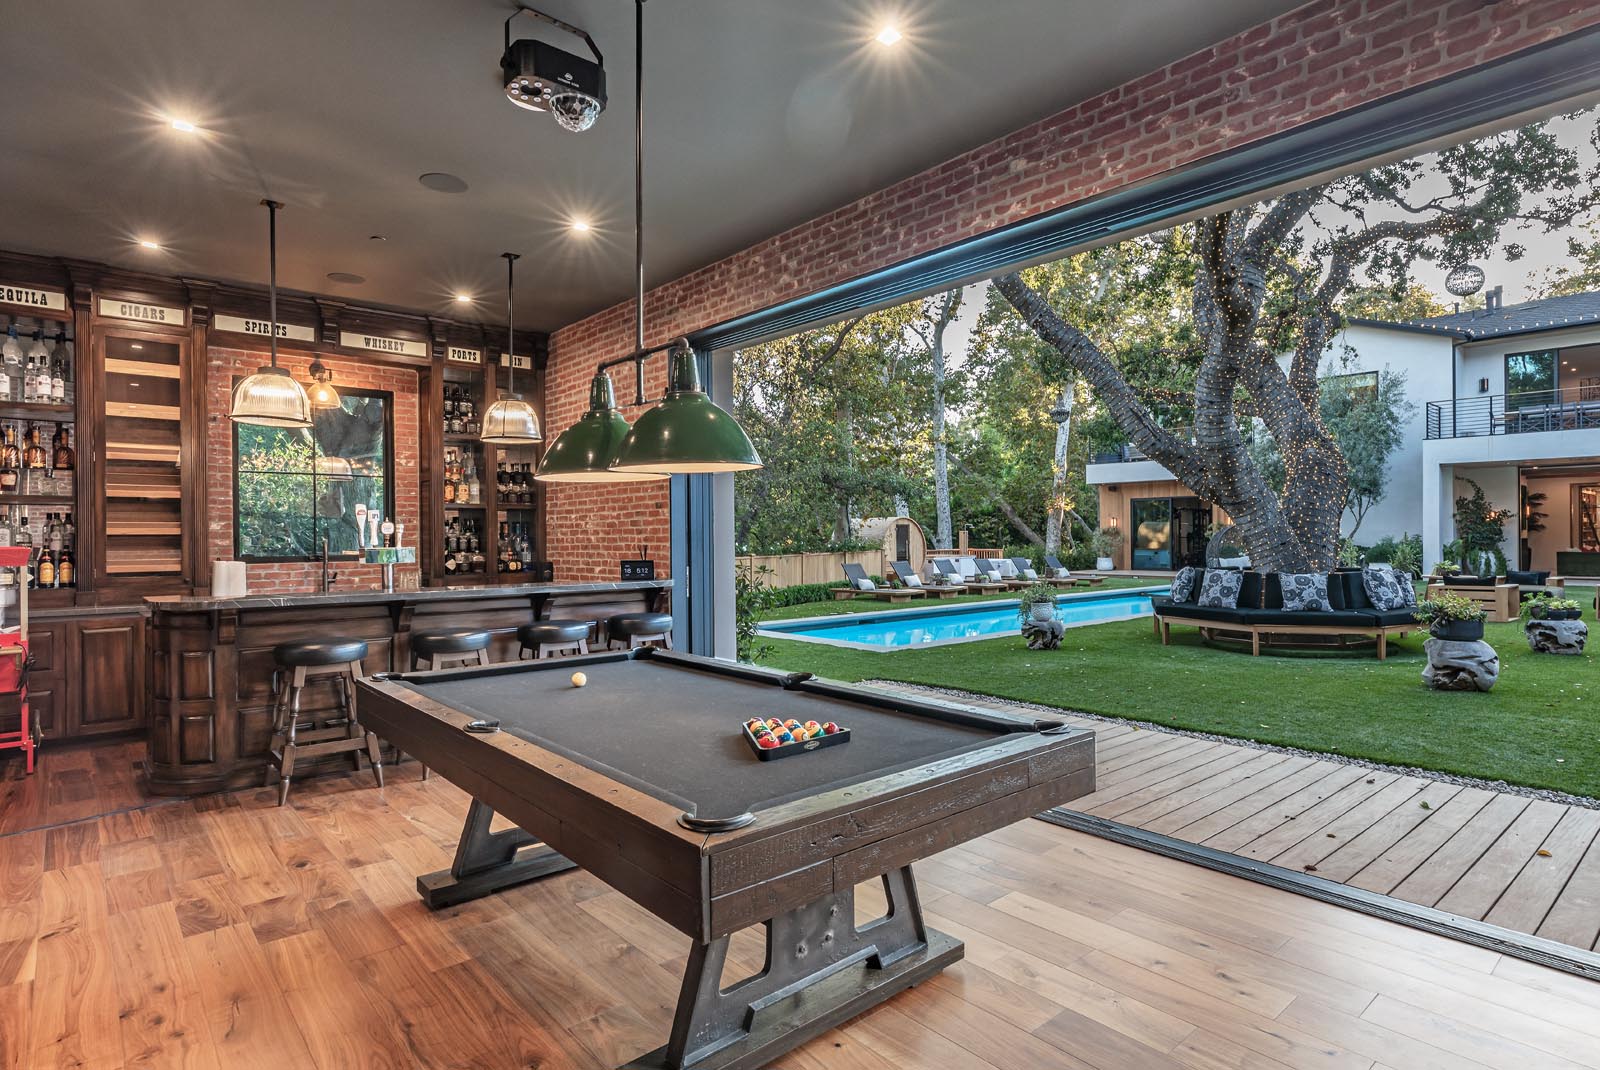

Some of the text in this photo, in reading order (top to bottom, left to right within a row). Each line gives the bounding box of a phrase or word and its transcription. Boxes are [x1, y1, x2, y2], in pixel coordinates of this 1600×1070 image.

[120, 304, 165, 321] CIGARS
[364, 337, 405, 352] WHISKEY
[452, 349, 477, 361] PORTS
